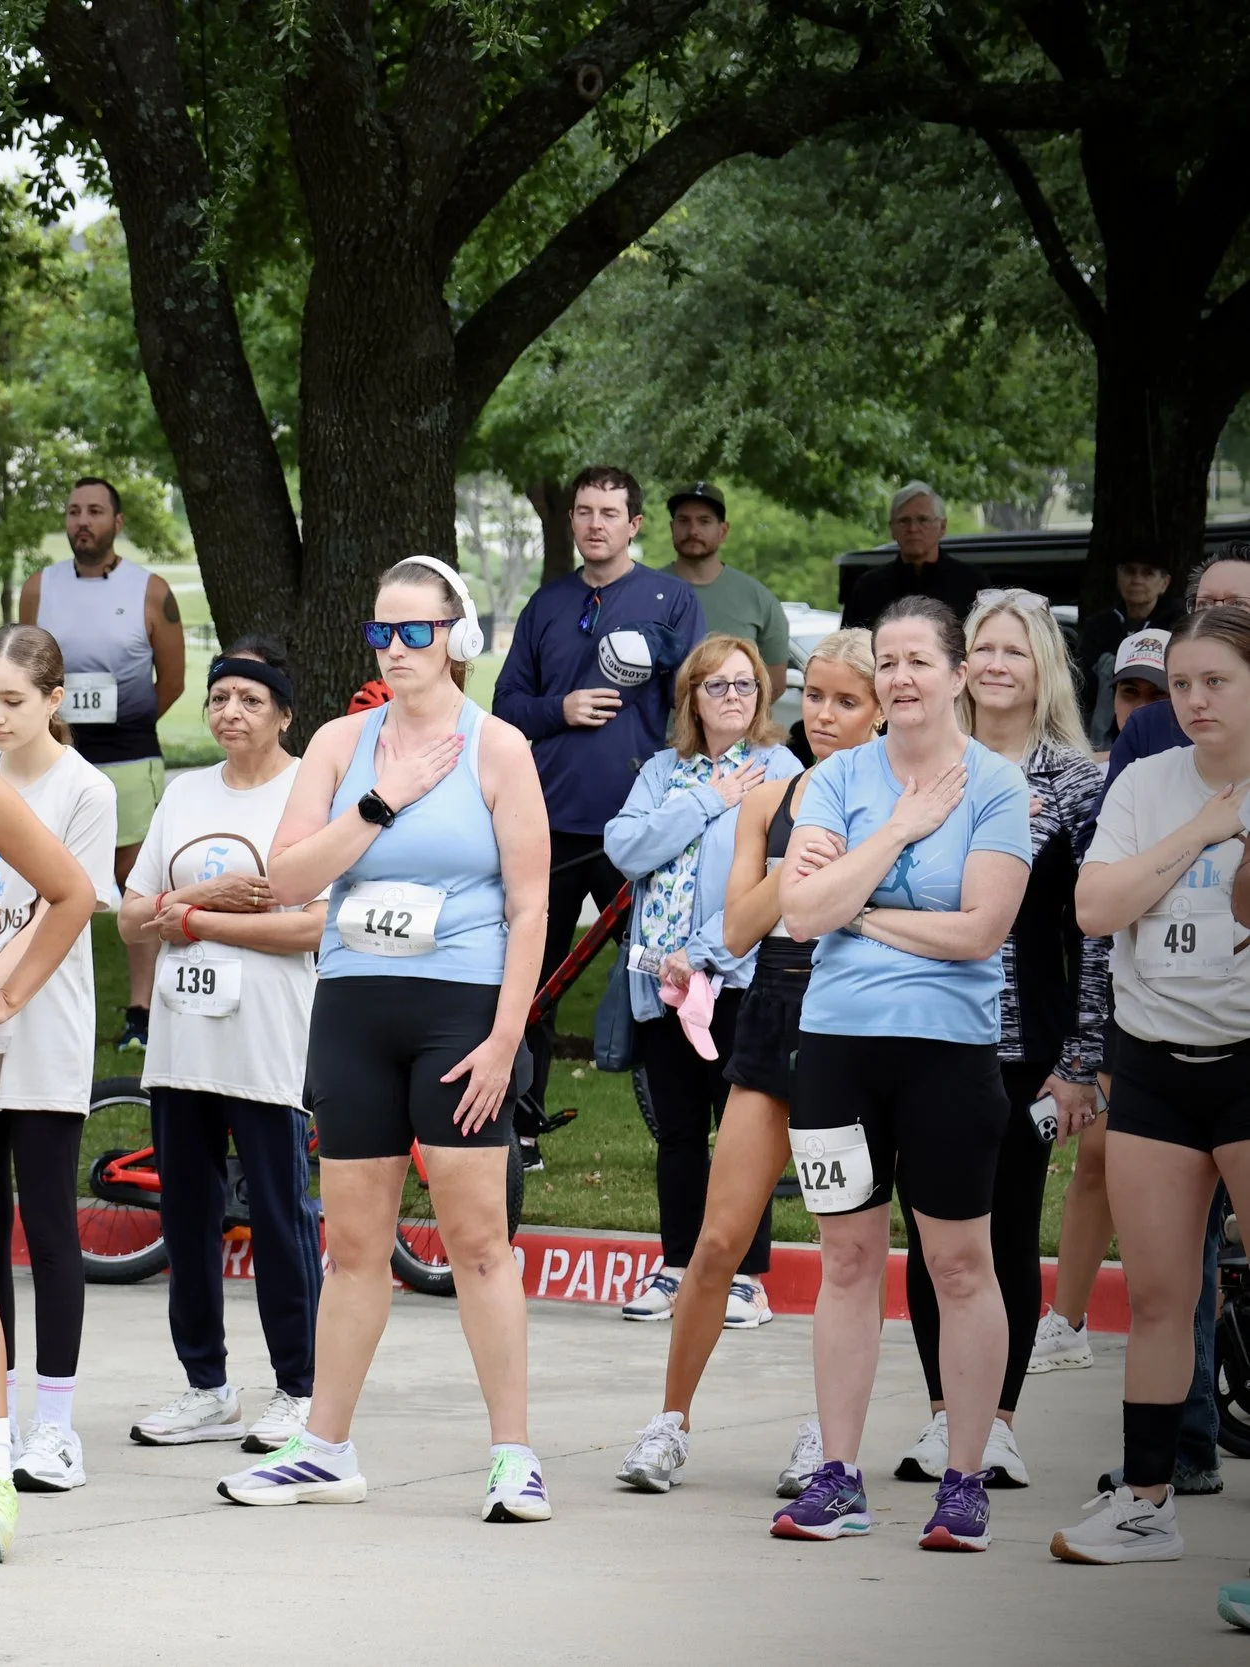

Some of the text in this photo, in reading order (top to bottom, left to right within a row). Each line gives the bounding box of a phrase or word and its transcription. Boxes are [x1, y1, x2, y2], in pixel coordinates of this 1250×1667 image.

[605, 655, 649, 679] COWBOYS
[72, 691, 101, 709] 118
[364, 908, 412, 939] 142
[1163, 923, 1196, 954] 49
[176, 966, 216, 995] 139
[801, 1160, 847, 1190] 124
